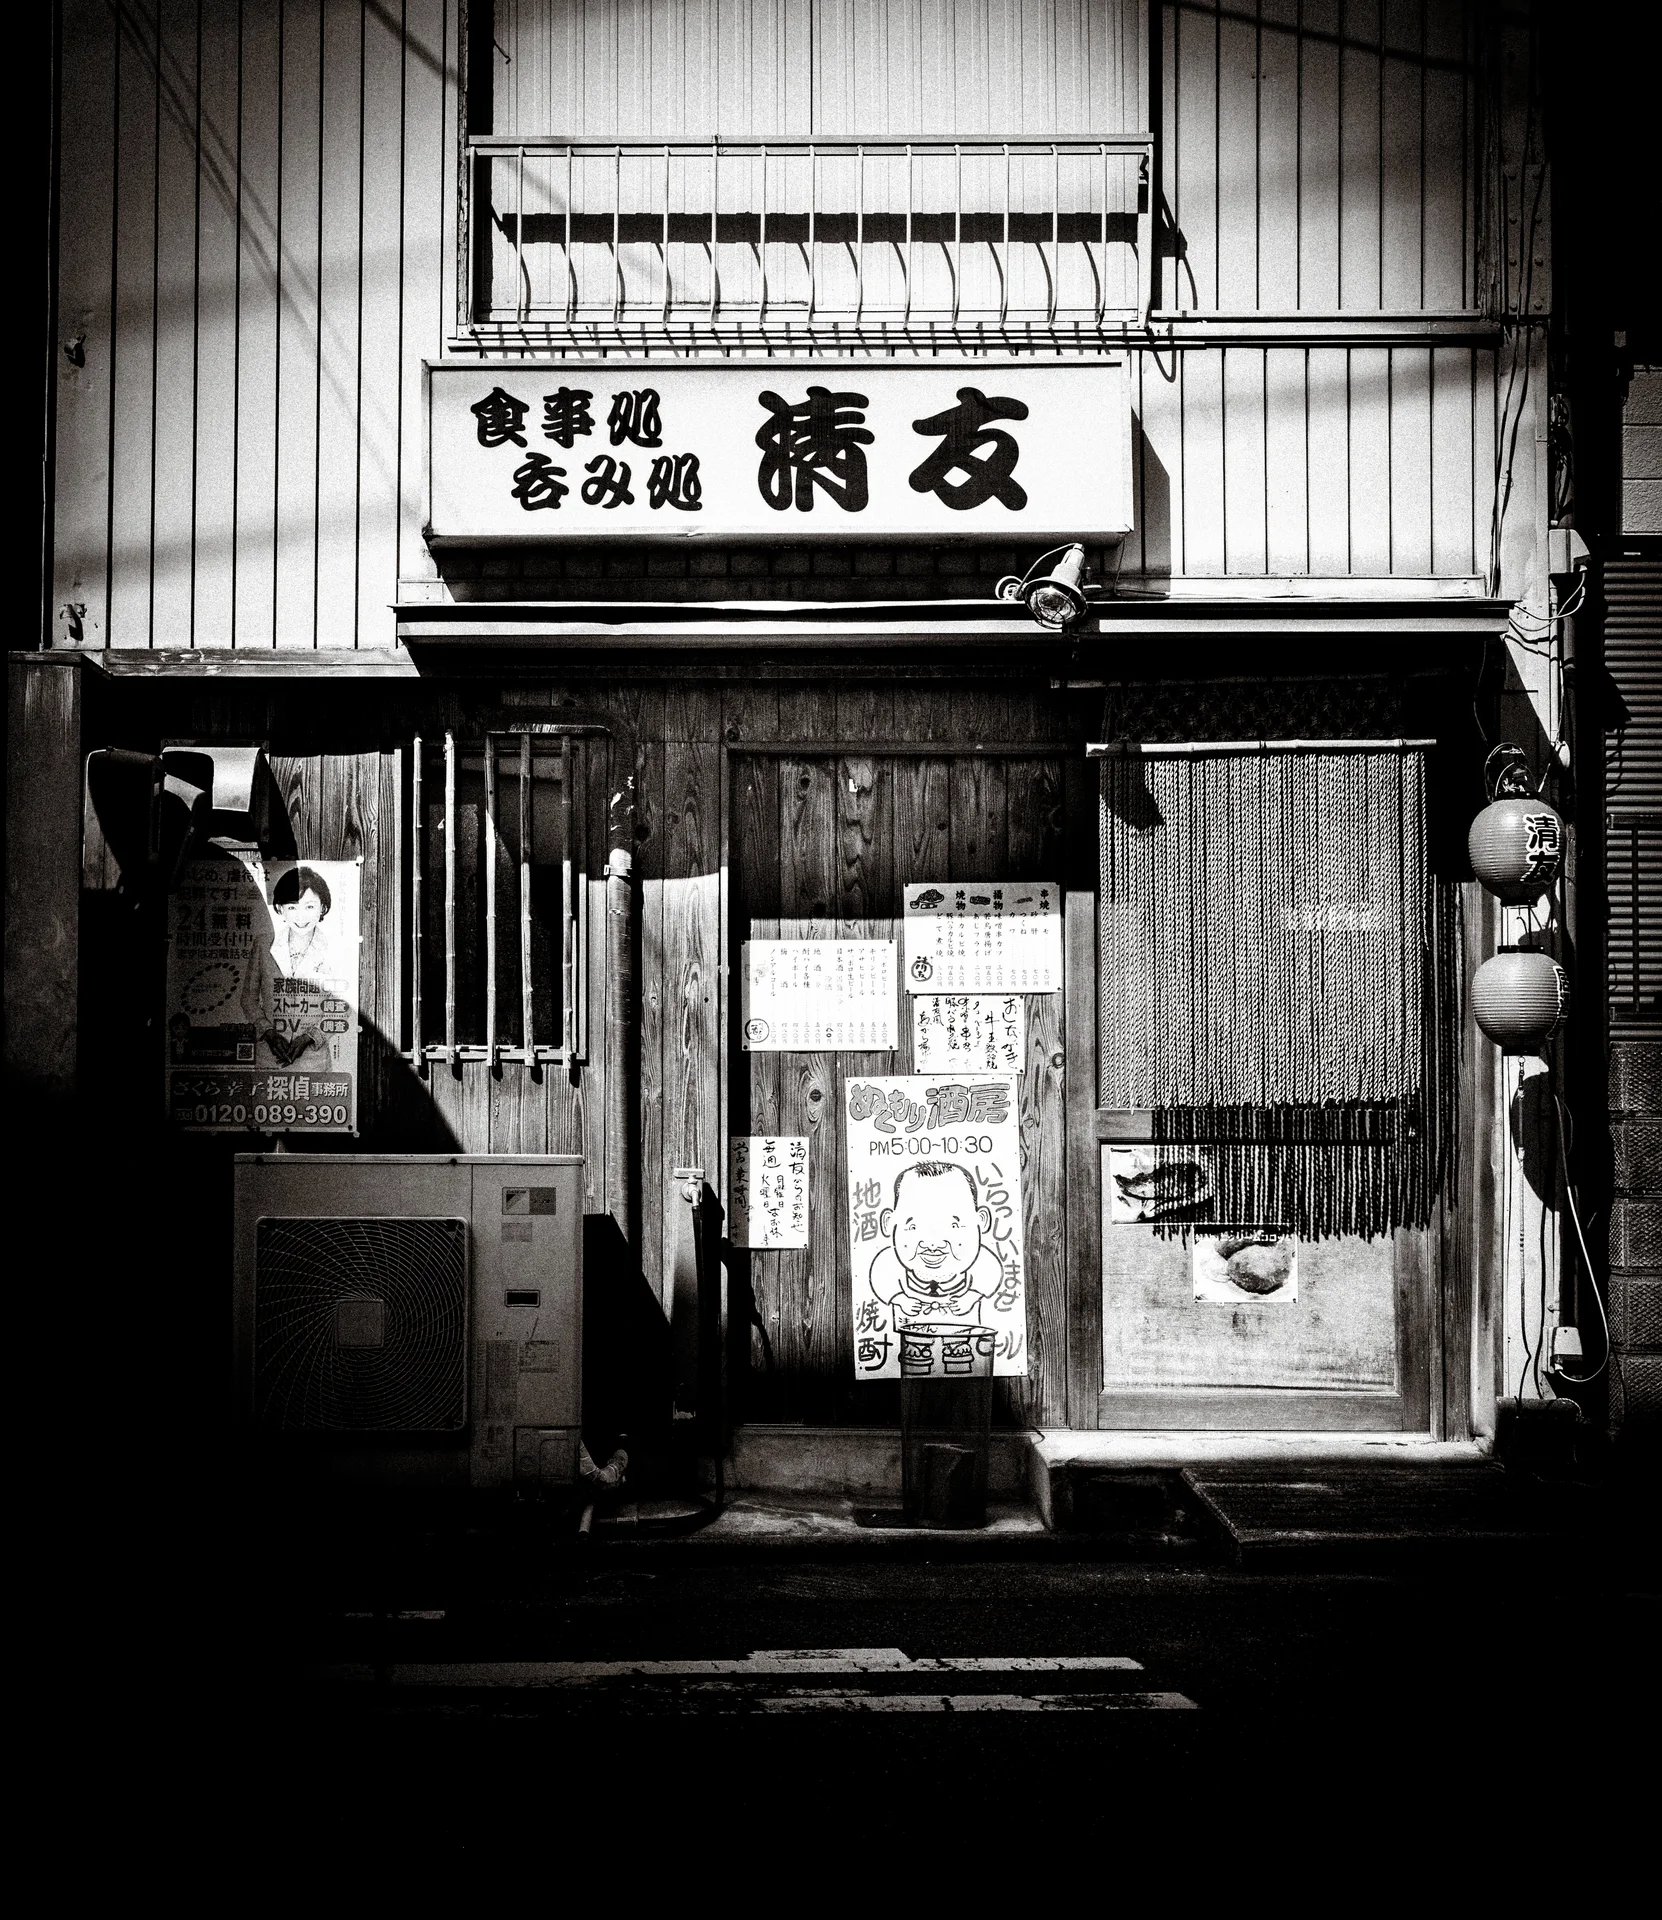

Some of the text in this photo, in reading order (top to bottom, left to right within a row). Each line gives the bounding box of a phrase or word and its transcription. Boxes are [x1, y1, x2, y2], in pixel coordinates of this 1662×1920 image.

[470, 386, 664, 449] 食事処
[755, 385, 1030, 512] 清友
[510, 452, 703, 511] 呑み処
[1523, 813, 1560, 885] 清友
[956, 890, 966, 911] 焼物
[1039, 888, 1050, 910] 串焼
[176, 931, 254, 947] 時間受付中
[273, 977, 320, 994] 家族問題
[273, 998, 346, 1013] ストーカー 調査
[273, 1018, 301, 1033] DV
[323, 1020, 346, 1033] 調査
[1001, 997, 1019, 1070] おしながき
[195, 1104, 347, 1124] 0120-089-390
[849, 1082, 1011, 1133] ぬくもり酒房
[853, 1177, 881, 1243] 地酒
[856, 1299, 893, 1371] 焼酎
